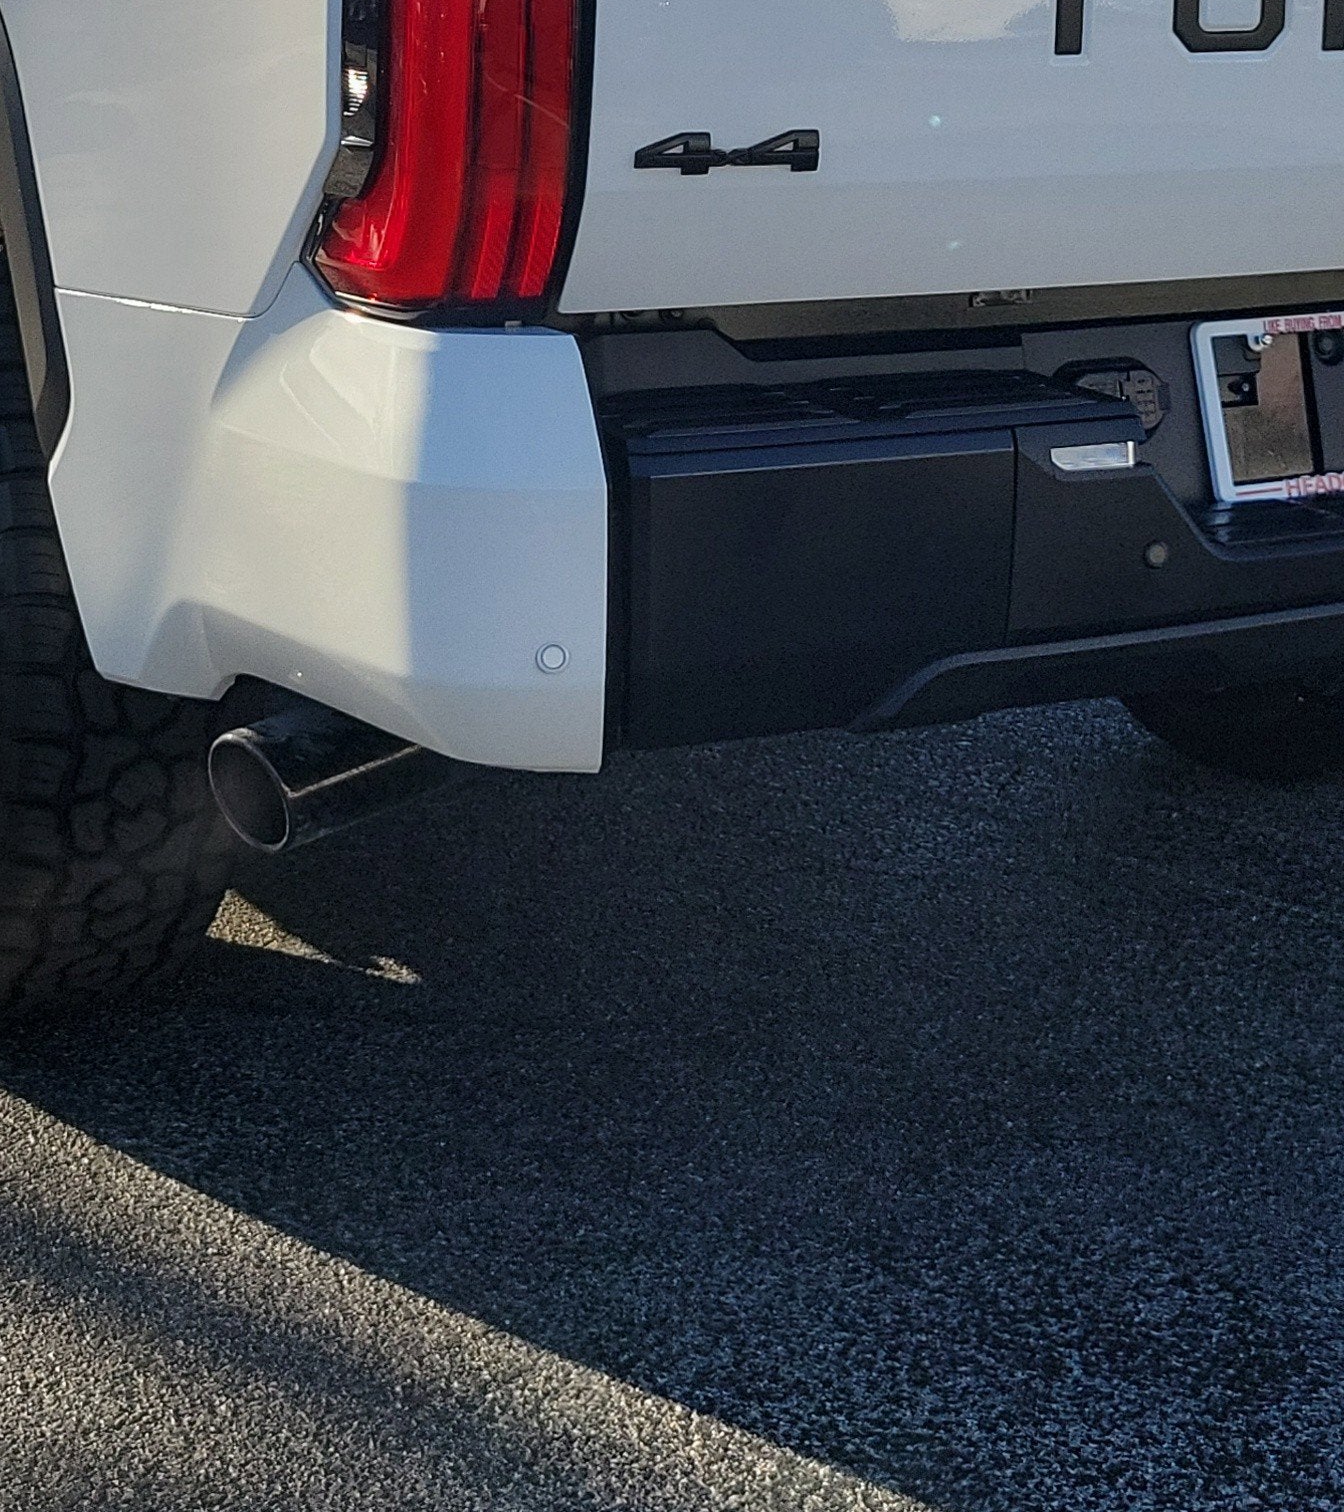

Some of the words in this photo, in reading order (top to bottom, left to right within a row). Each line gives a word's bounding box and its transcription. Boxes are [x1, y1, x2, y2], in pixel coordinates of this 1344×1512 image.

[1263, 319, 1280, 334] LIKE
[1284, 316, 1315, 333] BUYING
[1318, 314, 1342, 330] FROM
